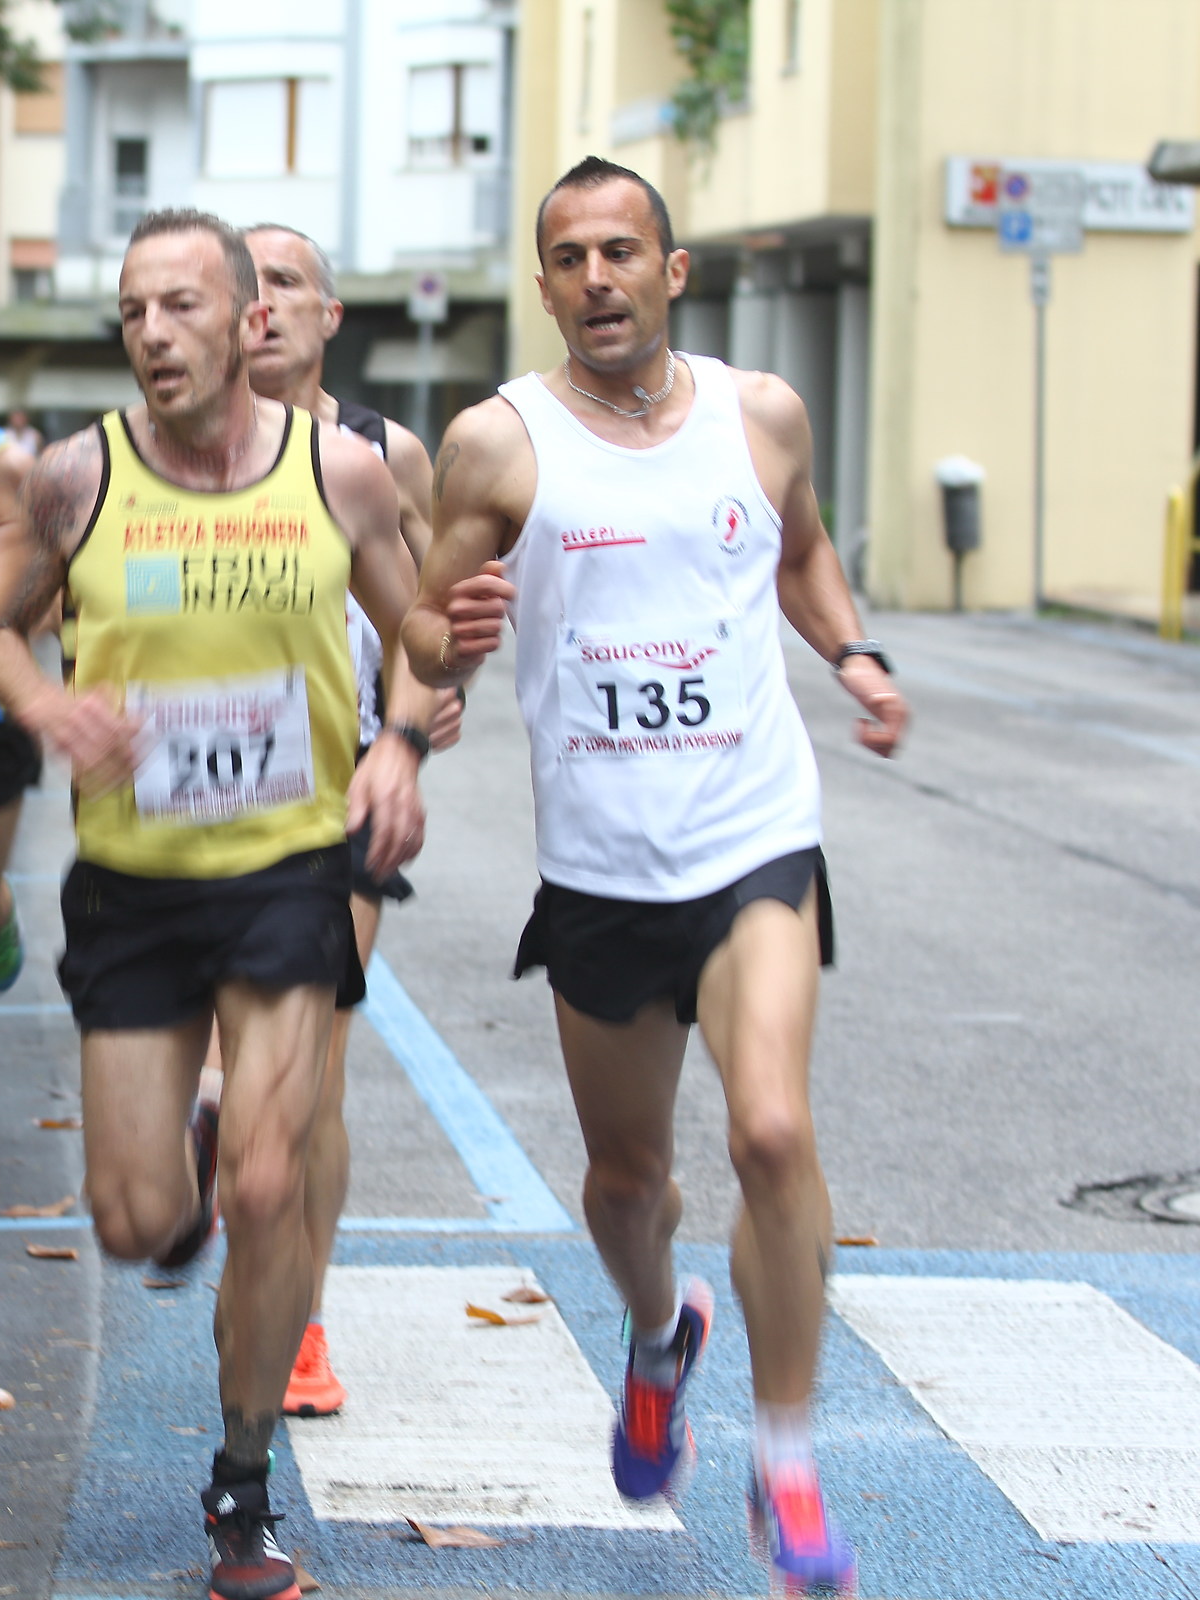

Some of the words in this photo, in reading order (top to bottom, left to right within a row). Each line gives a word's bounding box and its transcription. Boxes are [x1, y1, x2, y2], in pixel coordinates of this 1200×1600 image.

[580, 637, 689, 664] saucony
[596, 675, 711, 730] 135
[168, 731, 276, 795] 207
